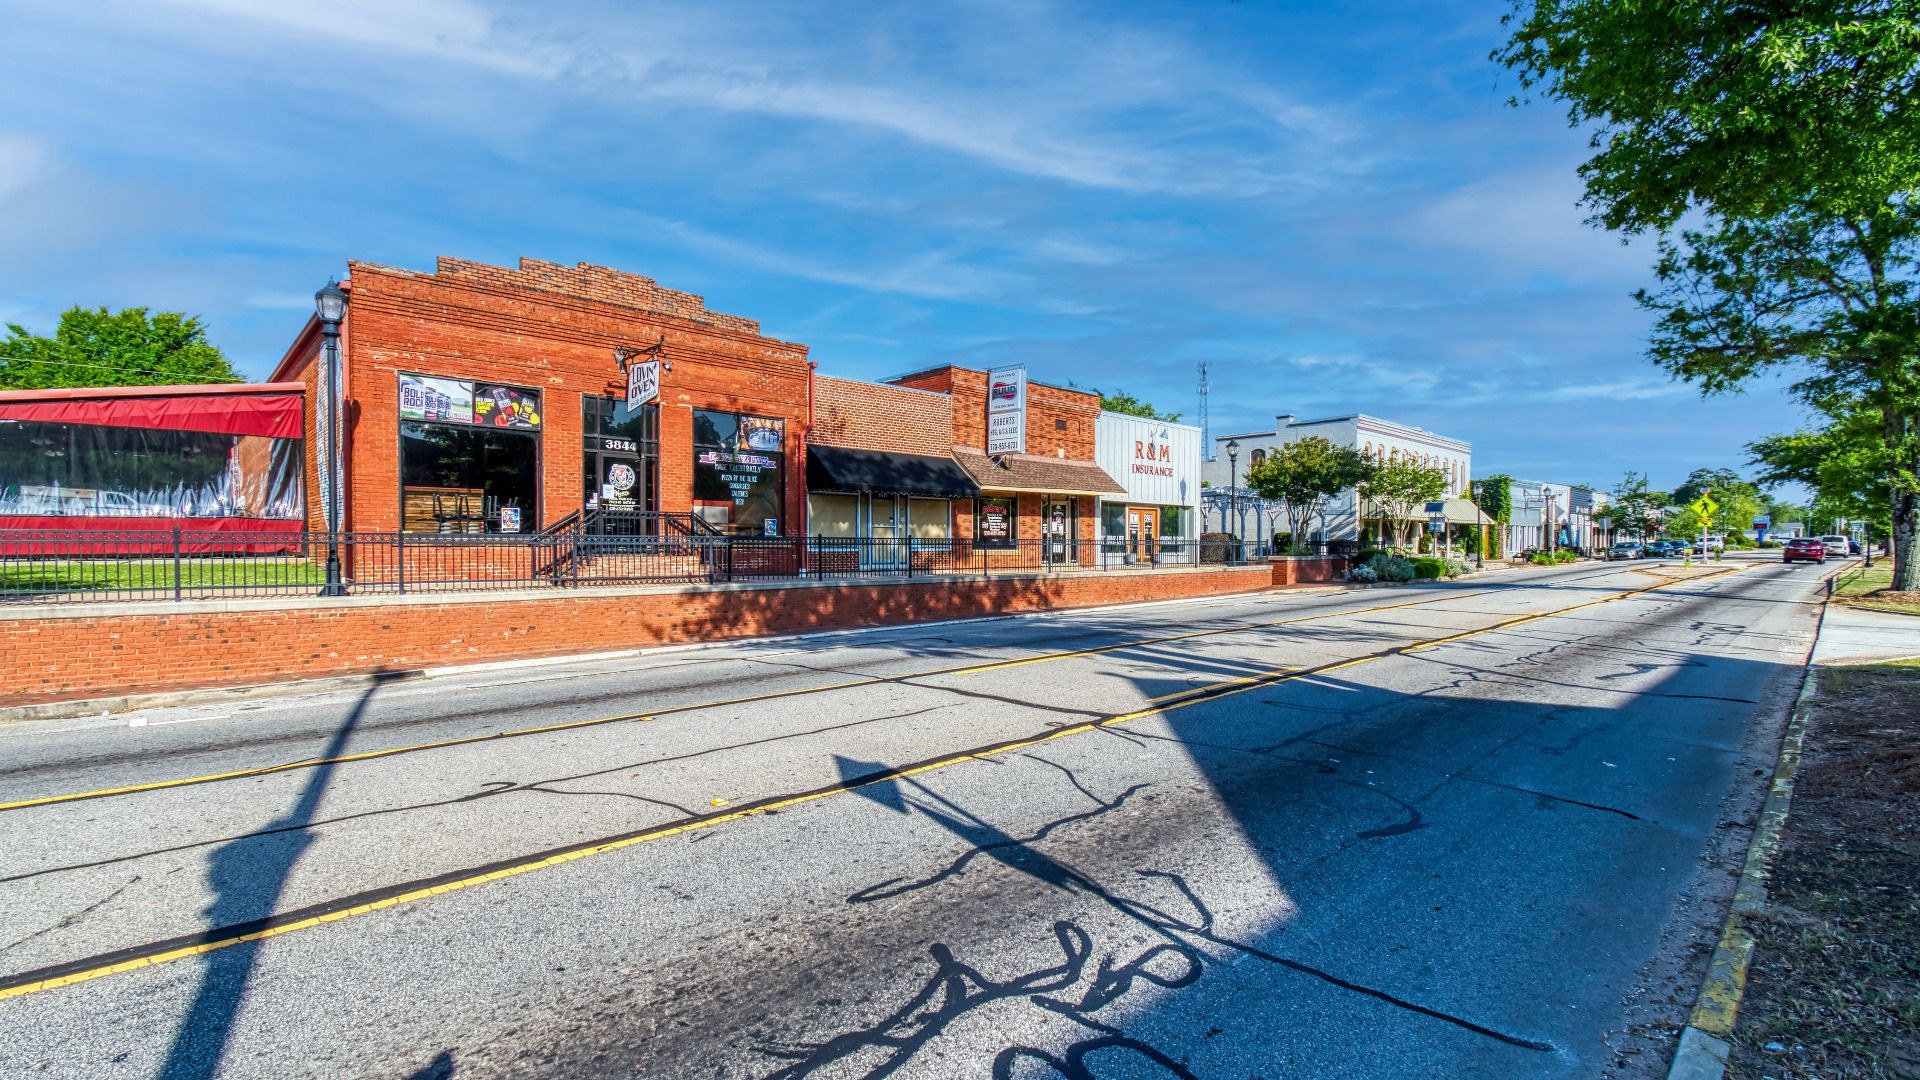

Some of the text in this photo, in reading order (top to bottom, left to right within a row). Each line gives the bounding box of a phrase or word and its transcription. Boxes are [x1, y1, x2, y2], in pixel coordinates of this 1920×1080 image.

[632, 363, 657, 384] LOVIN'
[404, 387, 424, 398] BOLD
[631, 376, 655, 398] OVEN
[993, 386, 1016, 396] RUUD
[993, 416, 1015, 426] ROBERTS
[605, 440, 637, 452] 3844
[1131, 463, 1173, 478] INSURANCE
